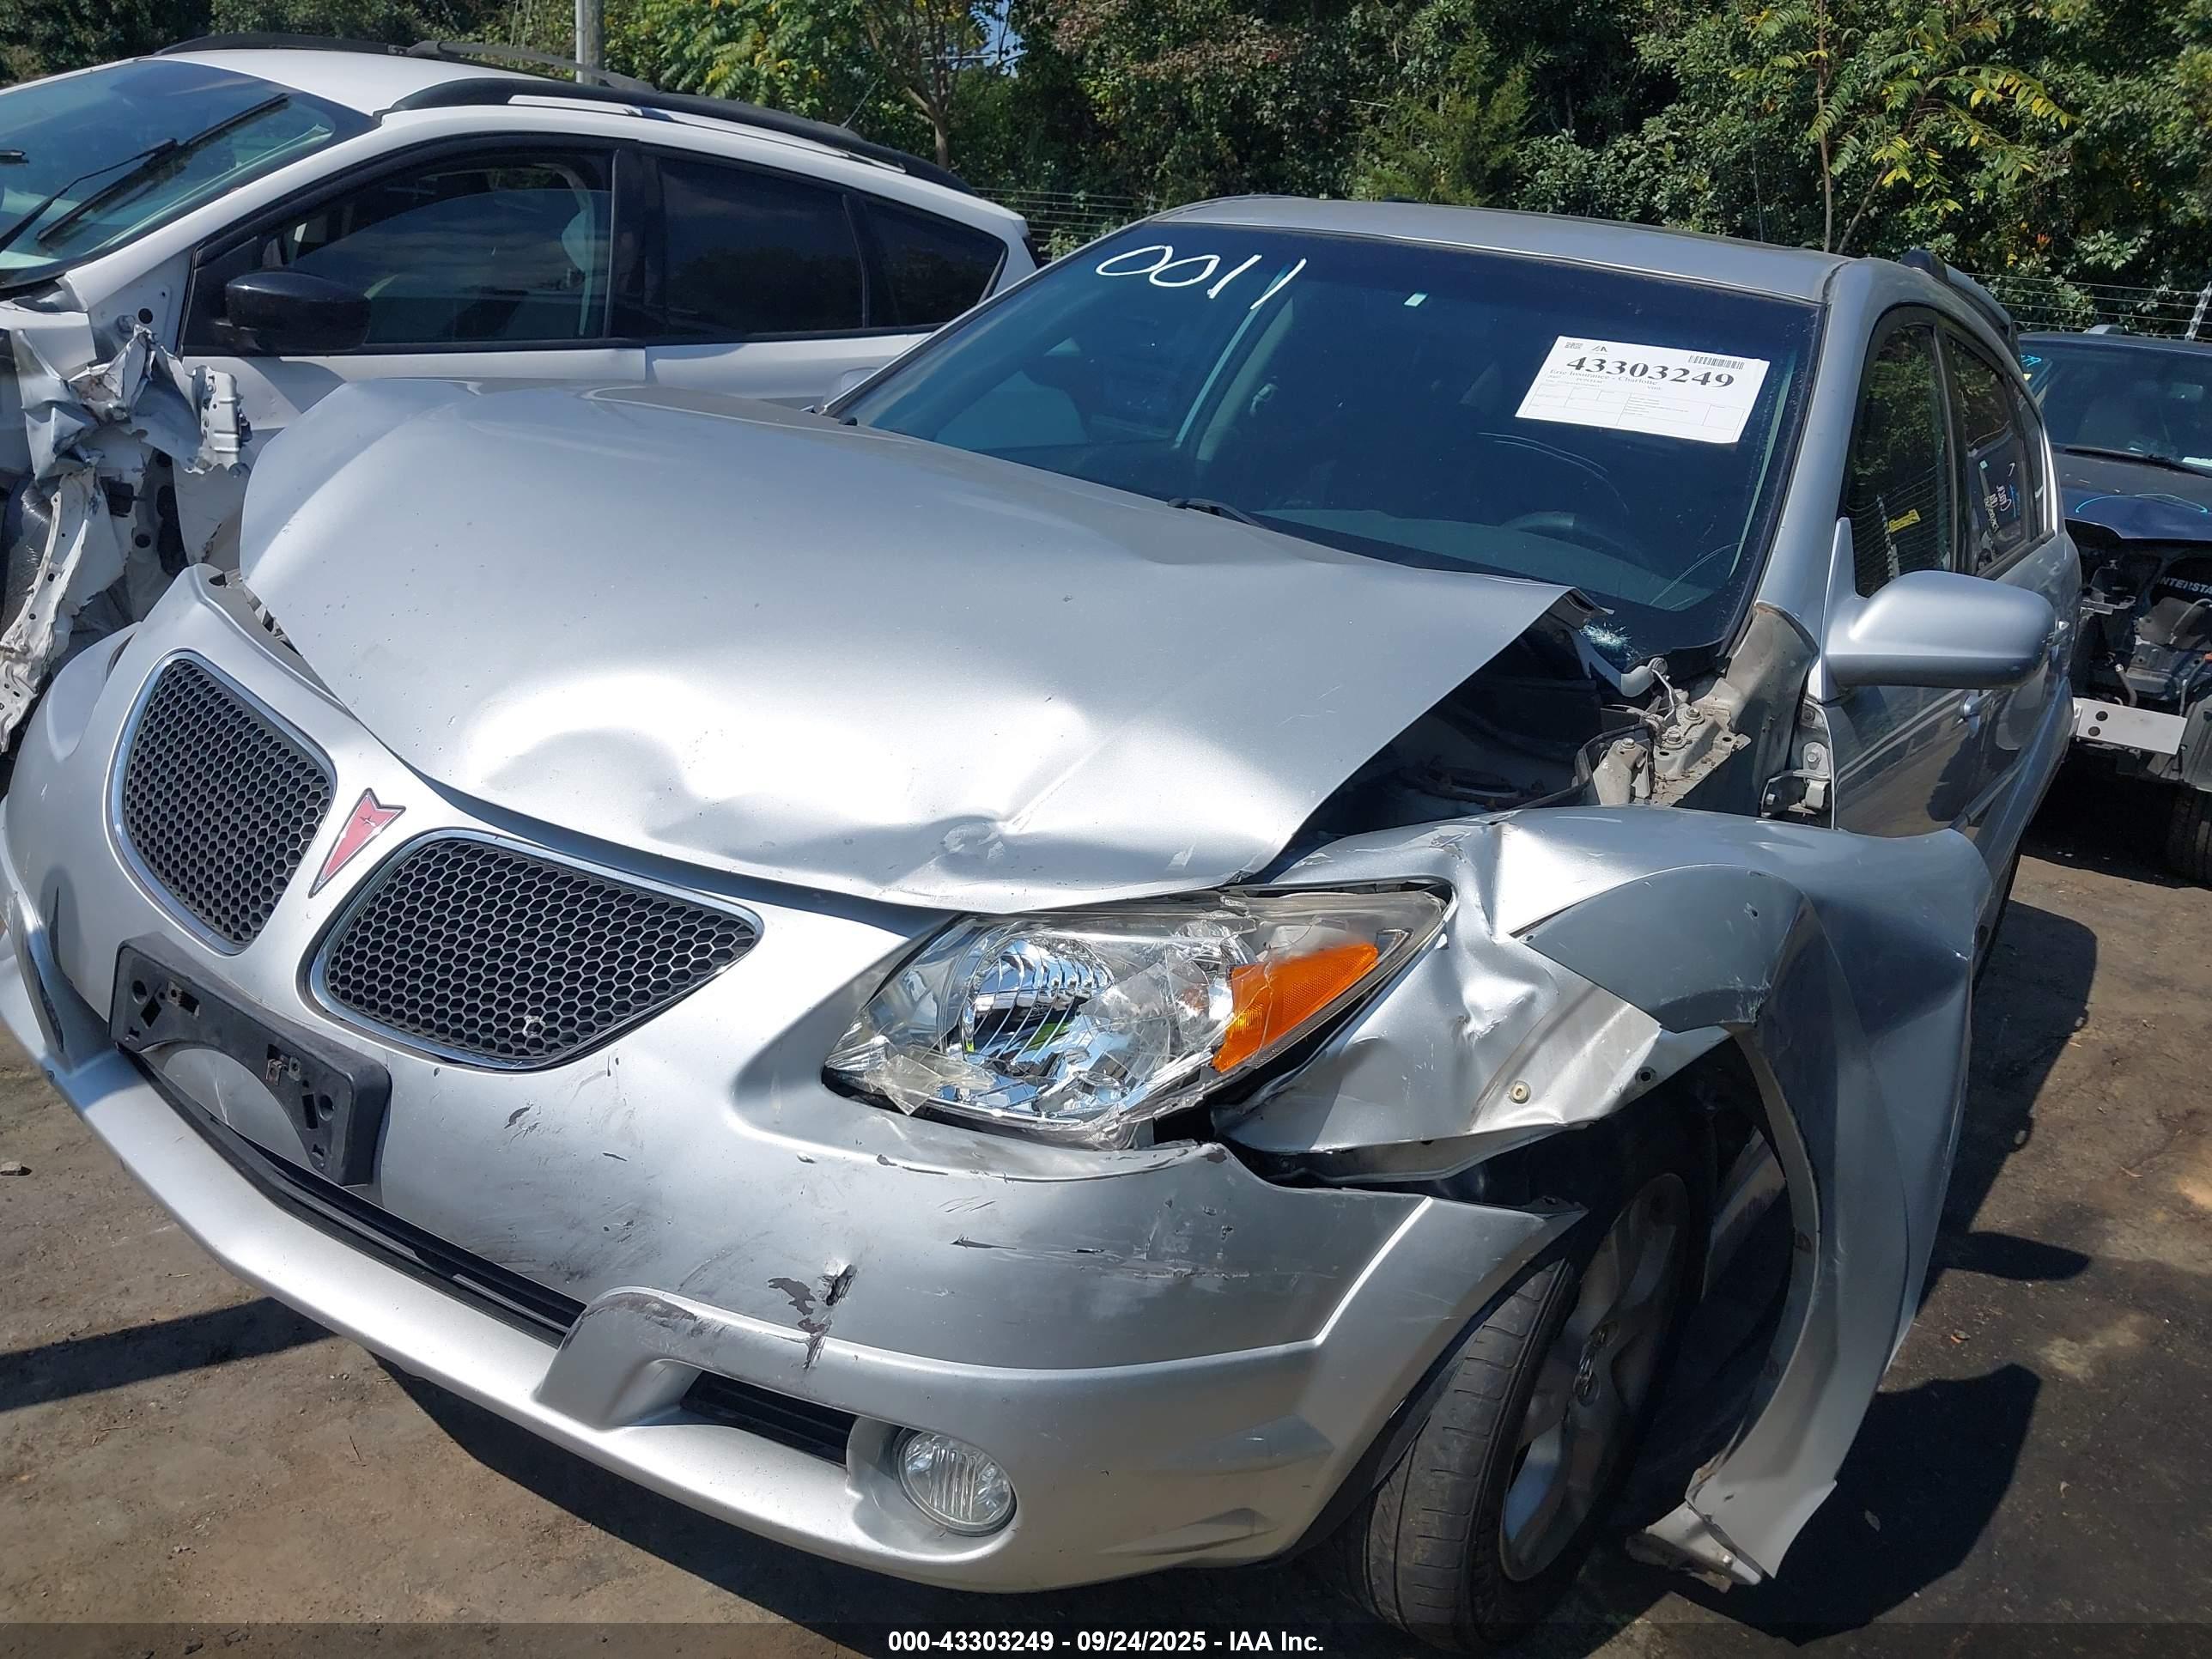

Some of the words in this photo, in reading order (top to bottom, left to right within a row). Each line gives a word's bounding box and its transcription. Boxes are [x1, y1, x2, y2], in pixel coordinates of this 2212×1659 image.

[1096, 245, 1308, 310] 0011
[1566, 356, 1735, 388] 43303249
[1568, 370, 1610, 380] Insurance
[1618, 375, 1658, 386] Charlotte
